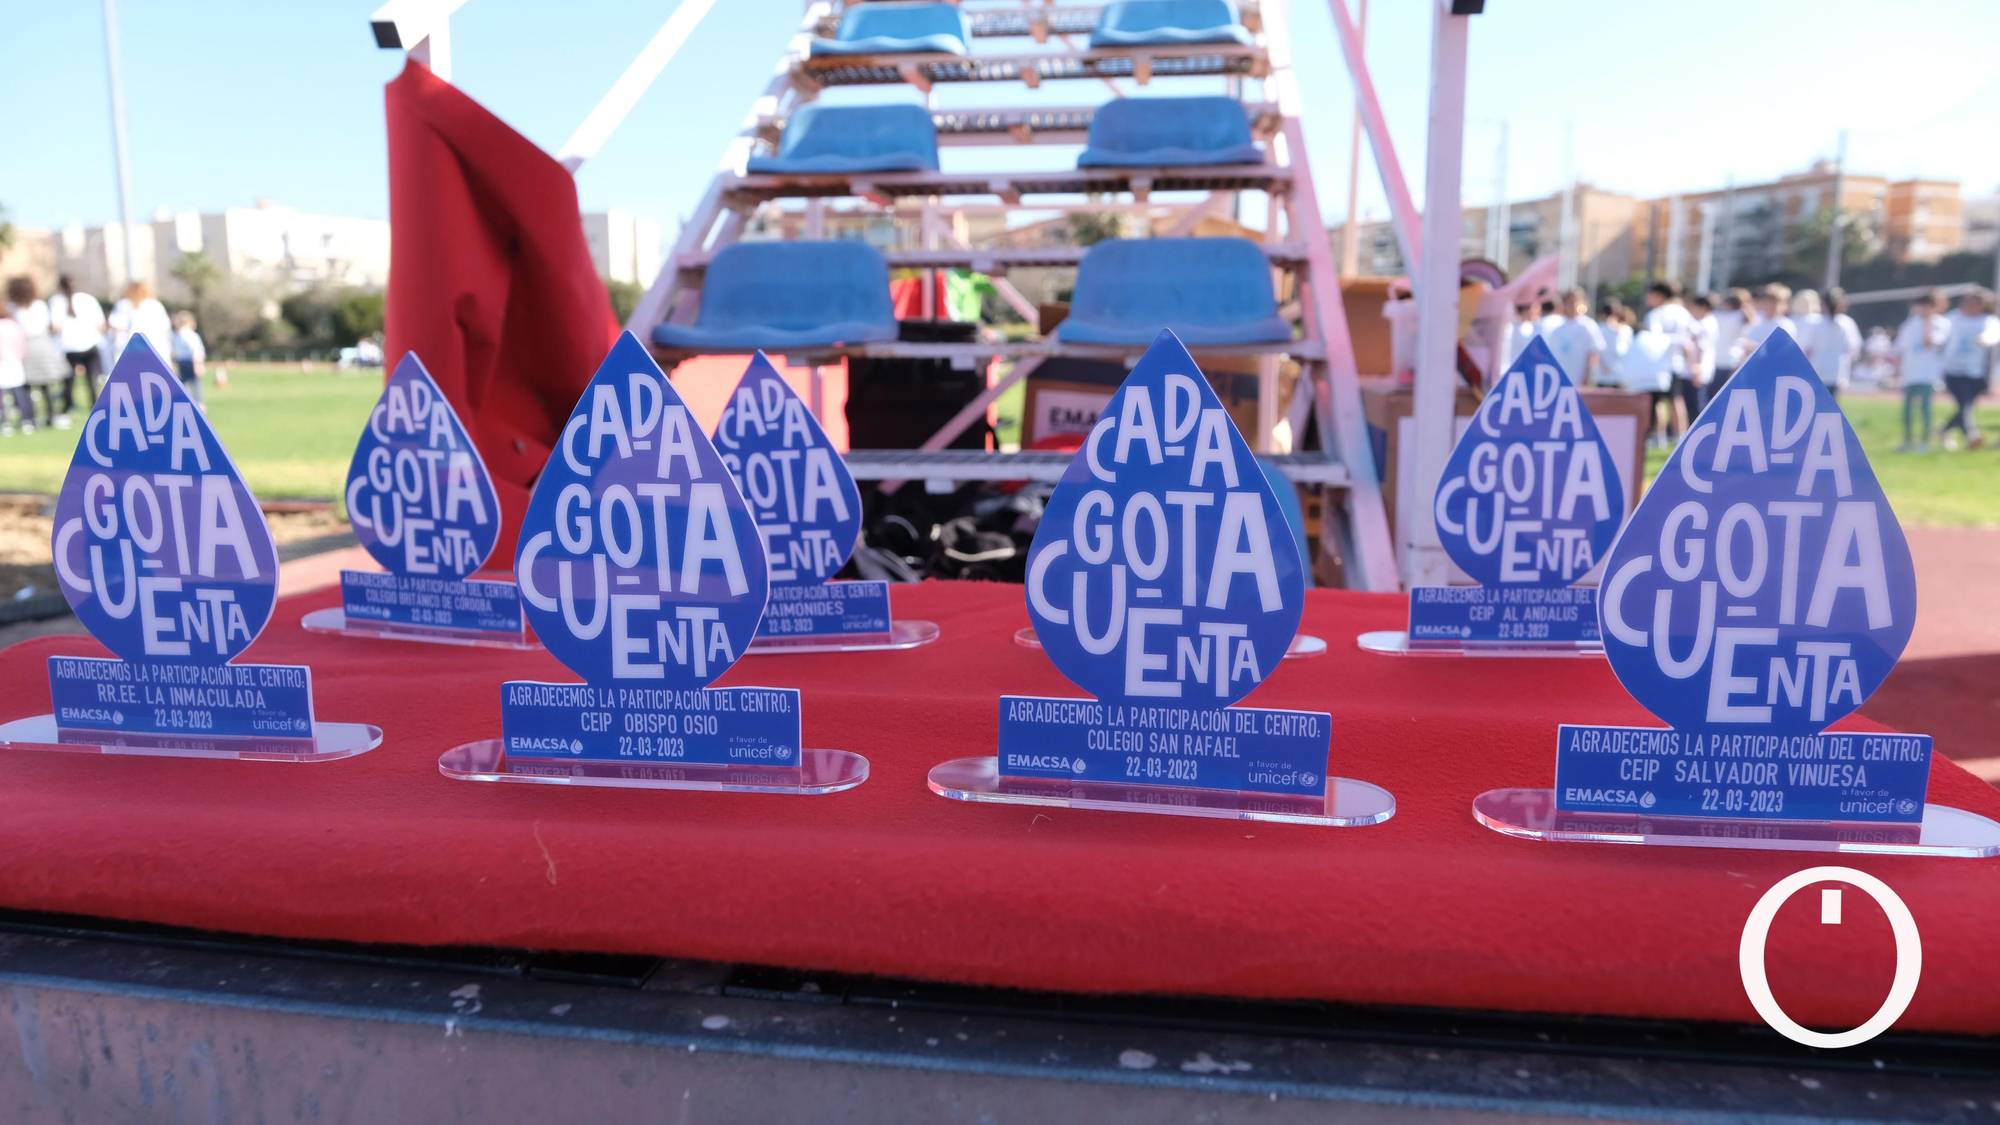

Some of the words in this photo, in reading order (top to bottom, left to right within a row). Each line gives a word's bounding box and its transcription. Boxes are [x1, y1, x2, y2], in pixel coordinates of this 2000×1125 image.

[720, 378, 814, 449] CADA
[1480, 363, 1583, 439] CADA
[86, 371, 211, 472] CADA
[370, 379, 457, 449] CADA
[562, 372, 702, 480] CADA
[1086, 374, 1239, 488] CADA
[1680, 375, 1852, 497] CADA
[368, 446, 489, 525] GOTA
[1468, 440, 1610, 521] GOTA
[84, 473, 260, 580] GOTA
[347, 476, 482, 575] CUENTA
[1435, 477, 1593, 582] CUENTA
[555, 483, 749, 597] GOTA
[746, 500, 843, 580] ENTA
[1073, 490, 1283, 612] GOTA
[1659, 500, 1892, 630] GOTA
[55, 518, 252, 656] CUENTA
[344, 575, 396, 588] AGRADECEMOS
[399, 577, 409, 590] LA
[411, 577, 466, 595] PARTICIPACIÓN
[469, 584, 482, 597] DEL
[831, 585, 845, 599] DEL
[1417, 588, 1485, 603] AGRADECEMOS
[1487, 589, 1500, 603] LA
[1503, 586, 1572, 604] PARTICIPACIÓN
[1574, 590, 1591, 604] DEL
[346, 604, 381, 616] EMACSA
[366, 589, 397, 604] COLEGIO
[399, 590, 439, 607] BRITÁNICO
[442, 595, 452, 608] DE
[455, 595, 492, 612] CÓRDOBA
[519, 531, 735, 680] CUENTA
[411, 608, 452, 624] 22-03-2023
[478, 617, 506, 628] unicef
[768, 619, 813, 633] 22-03-2023
[843, 619, 872, 629] unicef
[1028, 539, 1261, 697] CUENTA
[1469, 606, 1494, 621] CEIP
[1503, 606, 1519, 621] AL
[1523, 607, 1577, 621] ANDALUS
[1415, 625, 1460, 636] EMACSA
[1499, 624, 1548, 637] 22-03-2023
[1603, 555, 1863, 722] CUENTA
[56, 660, 131, 681] AGRADECEMOS
[134, 665, 149, 682] LA
[152, 664, 232, 685] PARTICIPACIÓN
[236, 668, 256, 686] DEL
[260, 668, 305, 688] CENTRO:
[97, 684, 141, 703] RR.EE.
[146, 686, 165, 705] LA
[170, 687, 266, 709] INMACULADA
[510, 686, 595, 708] AGRADECEMOS
[600, 689, 615, 708] LA
[619, 687, 710, 711] PARTICIPACIÓN
[715, 691, 736, 711] DEL
[741, 692, 791, 713] CENTRO:
[61, 707, 112, 721] EMACSA
[154, 709, 212, 729] 22-03-2023
[253, 717, 292, 731] unicef
[581, 712, 612, 732] CEIP
[625, 713, 677, 734] OBISPO
[684, 714, 718, 735] OSIO
[1008, 701, 1103, 725] AGRADECEMOS
[1108, 706, 1125, 726] LA
[1130, 708, 1230, 732] PARTICIPACIÓN
[1235, 713, 1258, 734] DEL
[1264, 713, 1321, 738] CENTRO:
[511, 737, 569, 750] EMACSA
[619, 736, 684, 757] 22-03-2023
[730, 745, 773, 758] unicef
[1088, 729, 1143, 752] COLEGIO
[1149, 732, 1179, 755] SAN
[1183, 735, 1240, 758] RAFAEL
[1570, 730, 1679, 756] AGRADECEMOS
[1685, 734, 1704, 756] LA
[1711, 734, 1824, 760] PARTICIPACIÓN
[1830, 737, 1855, 761] DEL
[1863, 738, 1924, 762] CENTRO:
[1008, 754, 1070, 769] EMACSA
[1126, 756, 1197, 780] 22-03-2023
[1256, 760, 1278, 768] favor
[1620, 759, 1660, 781] CEIP
[1675, 760, 1778, 785] SALVADOR
[1788, 764, 1867, 787] VINUESA
[1249, 771, 1297, 786] unicef
[1566, 788, 1637, 803] EMACSA
[1702, 788, 1783, 813] 22-03-2023
[1850, 788, 1874, 796] favor
[1840, 798, 1894, 813] unicef
